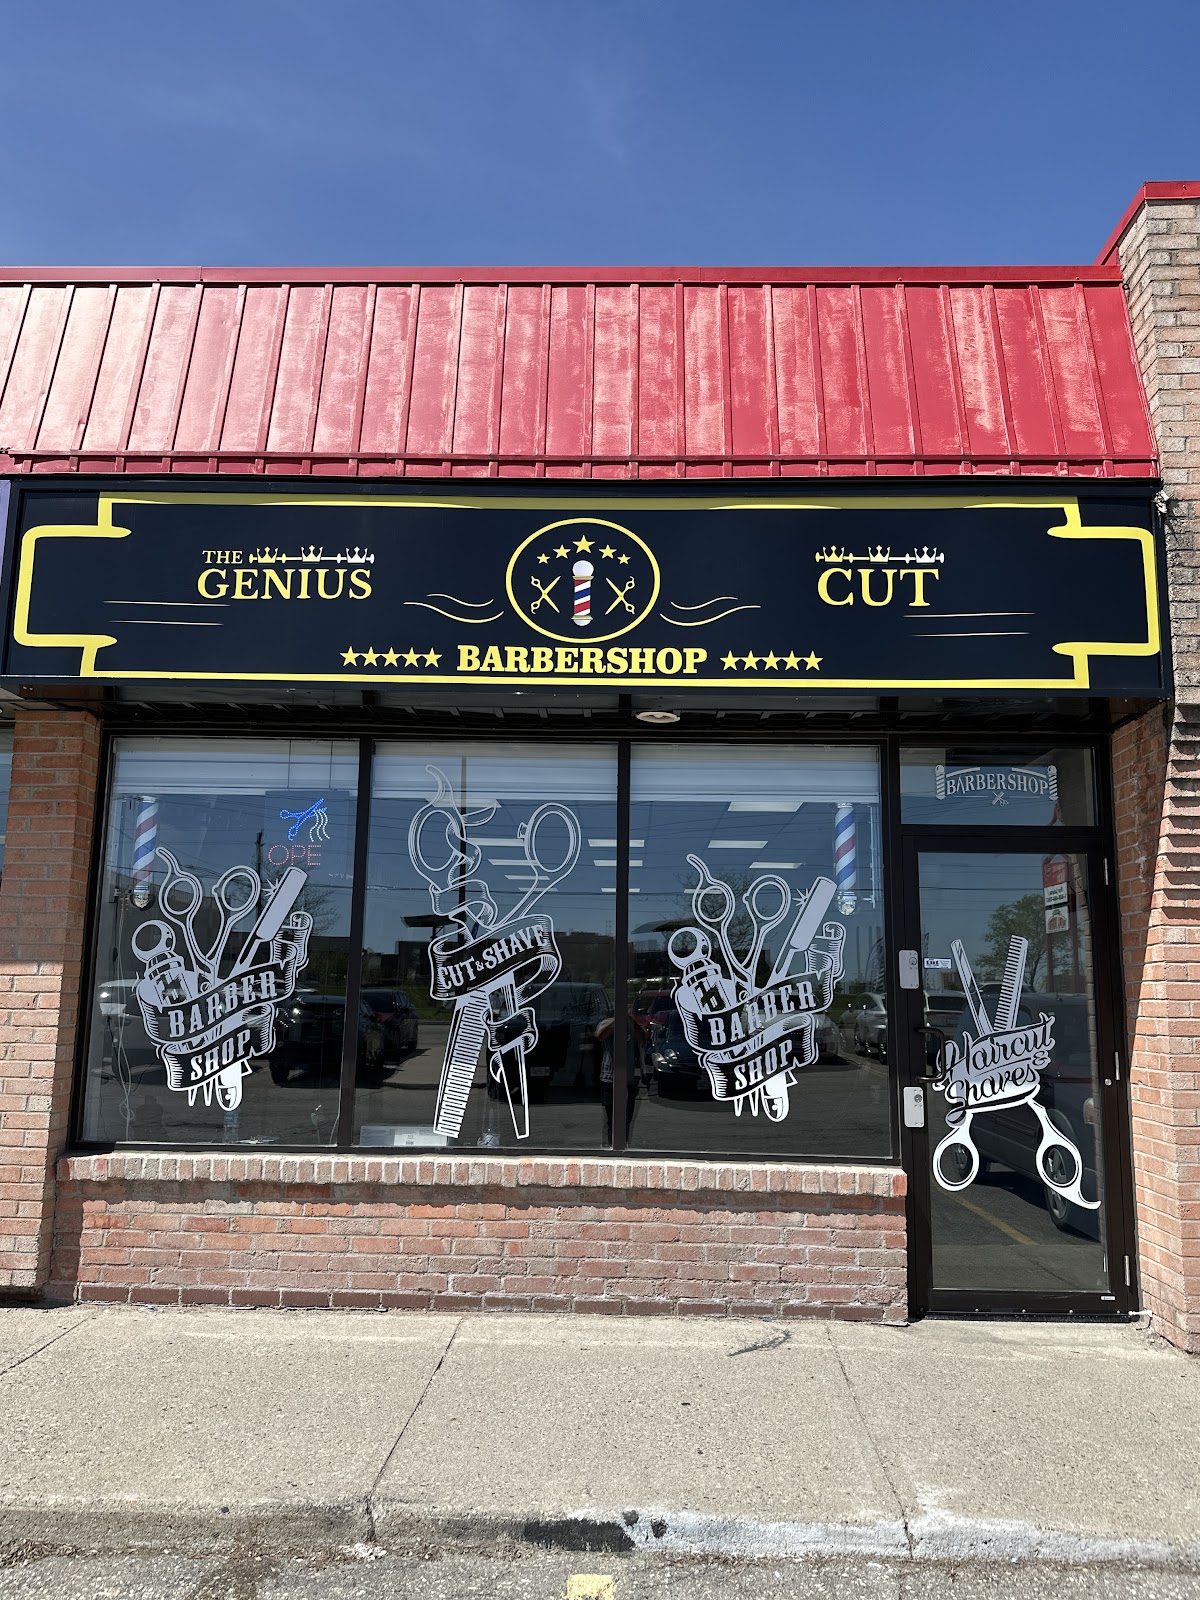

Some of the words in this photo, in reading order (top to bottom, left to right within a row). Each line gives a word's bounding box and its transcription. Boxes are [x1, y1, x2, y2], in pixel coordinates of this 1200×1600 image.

[202, 550, 243, 564] THE
[197, 568, 373, 600] GENIUS
[817, 567, 940, 607] CUT
[456, 644, 708, 675] BARBERSHOP
[946, 773, 1049, 796] BARBERSHOP
[168, 970, 278, 1038] BARBER
[708, 979, 817, 1046] BARBER
[190, 1029, 252, 1082] SHOP
[734, 1040, 793, 1090] SHOP
[936, 1015, 1053, 1084] Haircut
[1032, 1050, 1049, 1067] &
